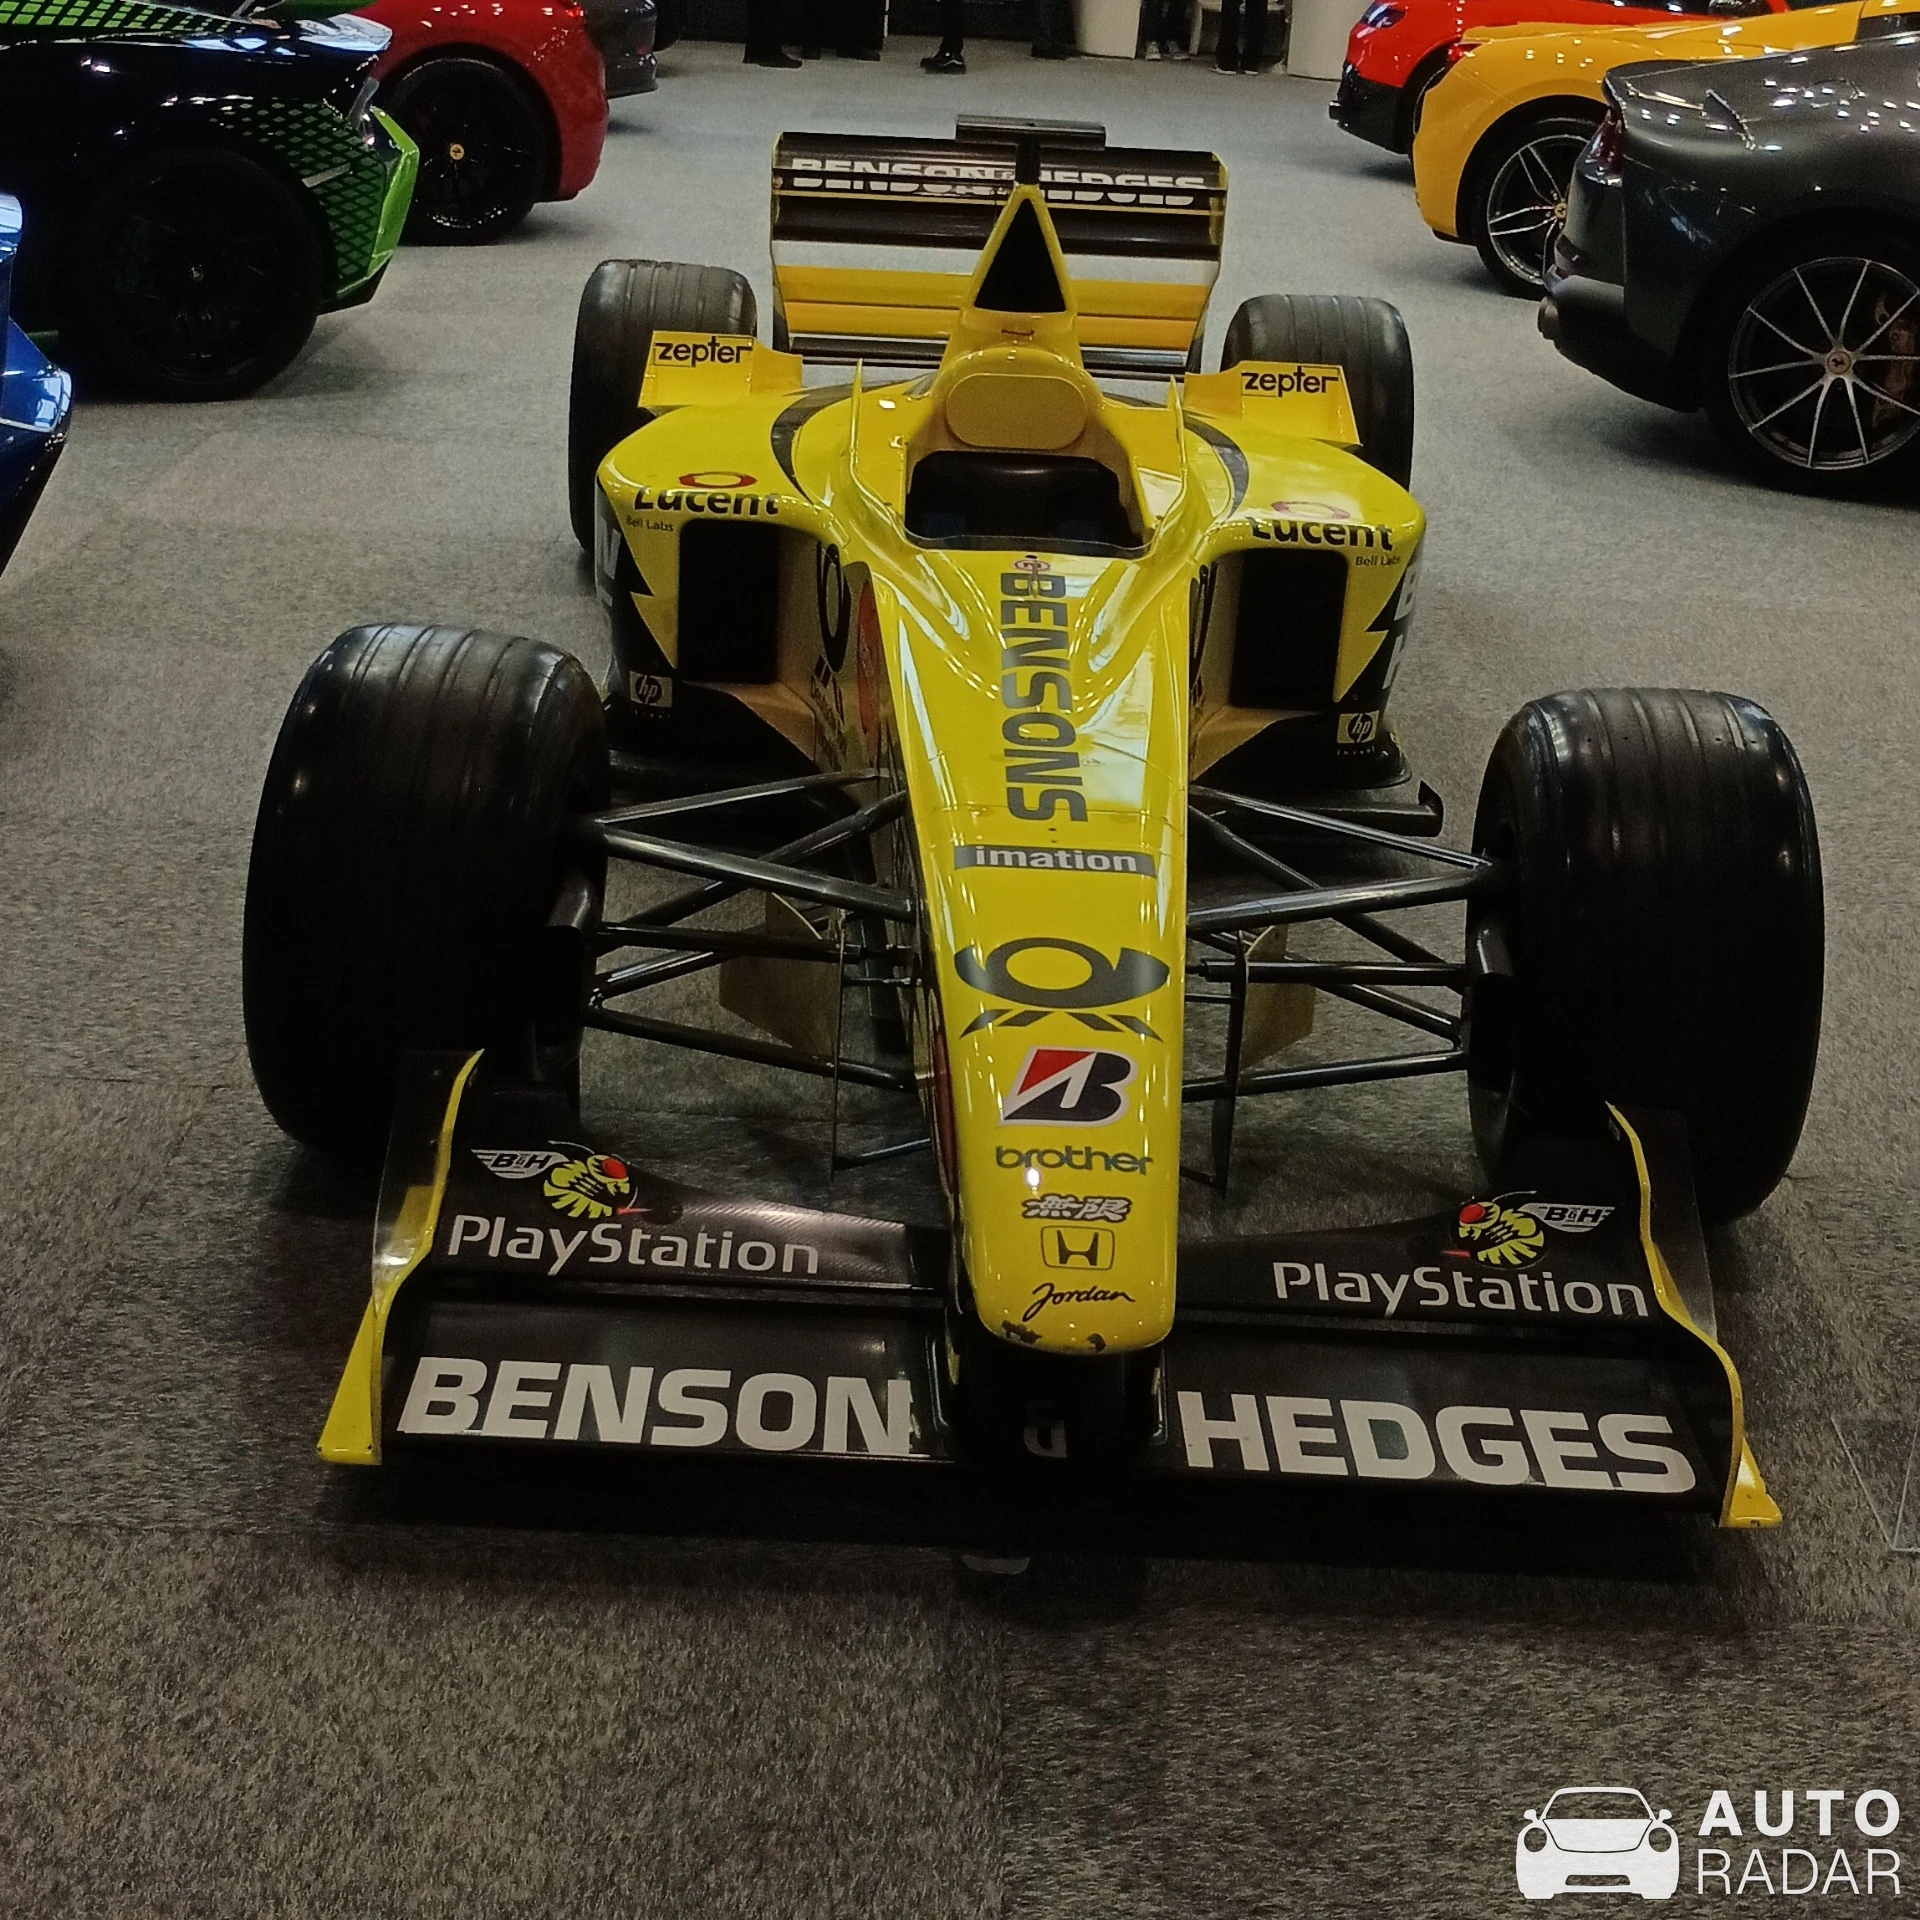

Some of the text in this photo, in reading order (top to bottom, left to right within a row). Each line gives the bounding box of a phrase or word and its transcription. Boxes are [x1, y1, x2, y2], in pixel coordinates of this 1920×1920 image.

[655, 336, 753, 367] zepter
[1241, 366, 1338, 397] zepter
[635, 487, 779, 516] Lucent
[646, 521, 674, 532] Labs
[1245, 516, 1393, 551] Lucent
[1355, 556, 1377, 566] Bell
[638, 674, 659, 705] hp
[1350, 712, 1371, 743] hp
[975, 845, 1137, 872] imation
[995, 1145, 1154, 1176] brother
[1023, 1194, 1132, 1223] 無限
[448, 1213, 820, 1276] PlayStation
[1022, 1282, 1136, 1322] Jordan
[1272, 1262, 1650, 1317] PlayStation
[397, 1356, 912, 1456] BENSON
[1177, 1391, 1697, 1494] HEDGES
